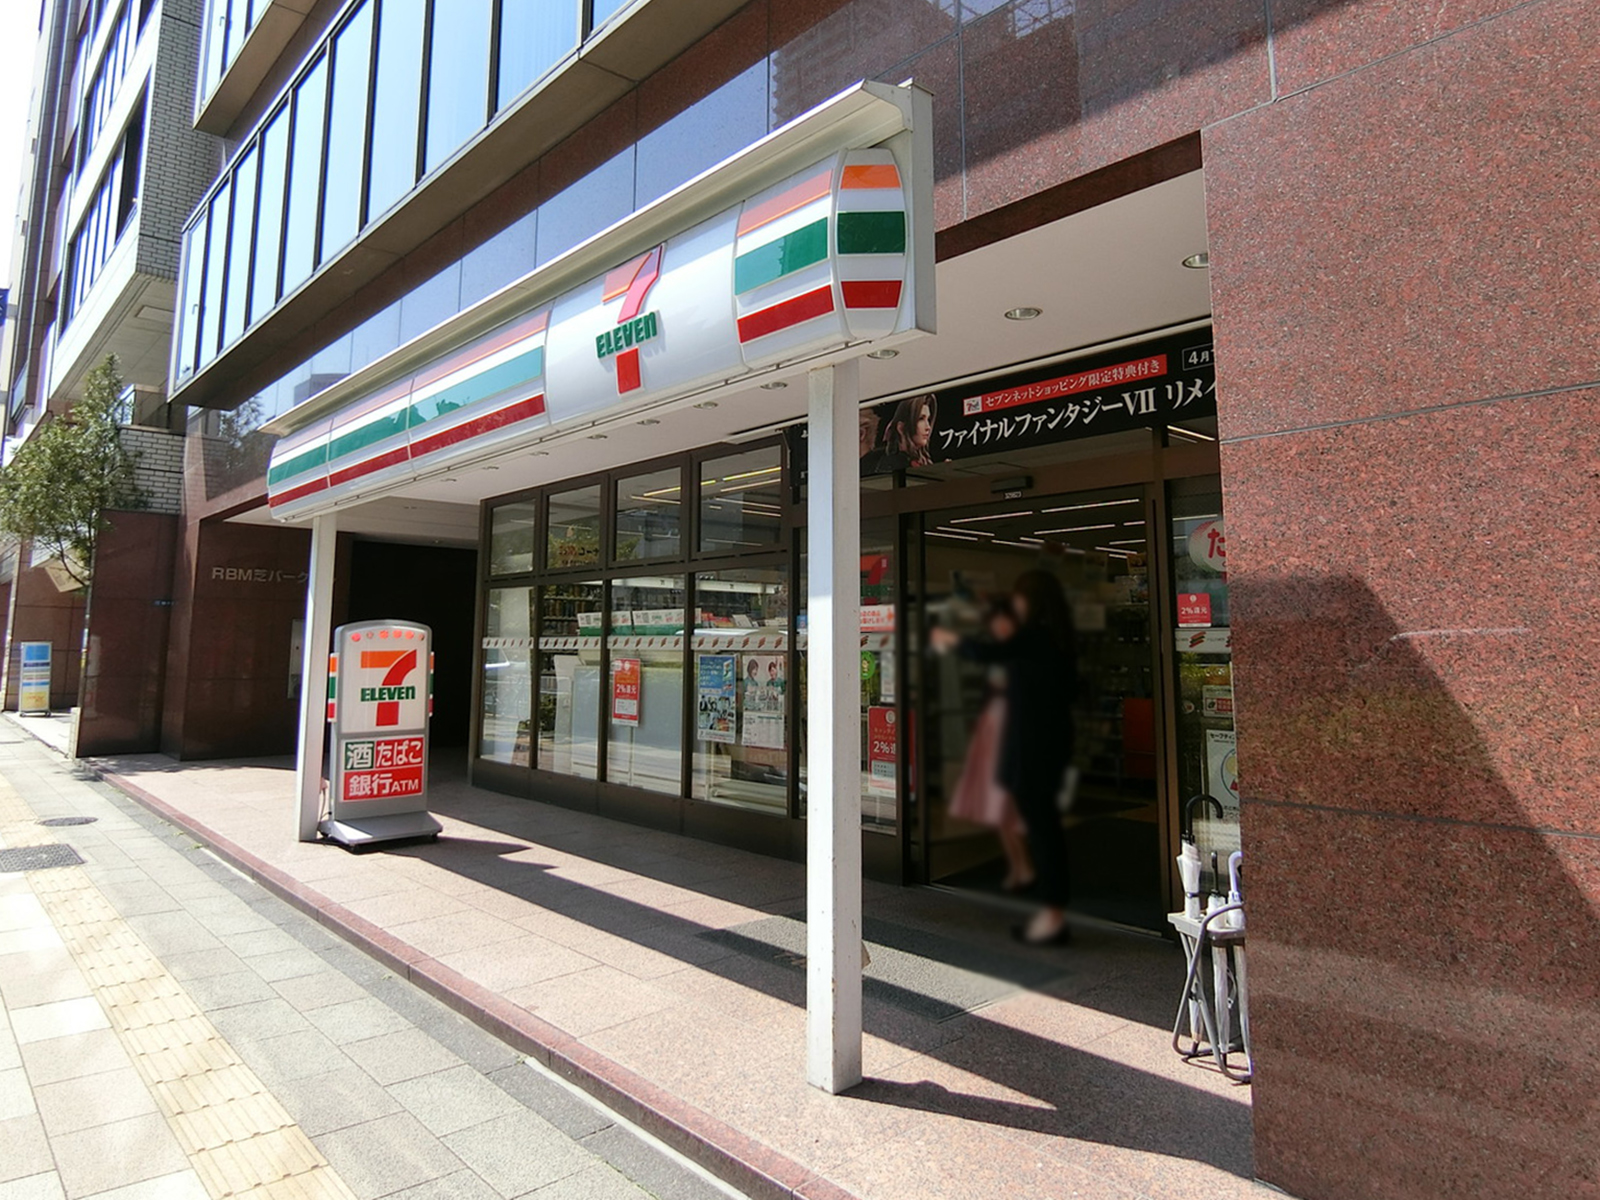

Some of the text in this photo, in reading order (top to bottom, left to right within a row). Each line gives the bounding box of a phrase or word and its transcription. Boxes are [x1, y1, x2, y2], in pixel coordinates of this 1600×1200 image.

[595, 312, 658, 359] ELEVEN
[985, 359, 1160, 408] セブンネットショッピング限定特典付き
[360, 686, 416, 703] ELEVEN
[346, 740, 422, 769] 酒 たばこ
